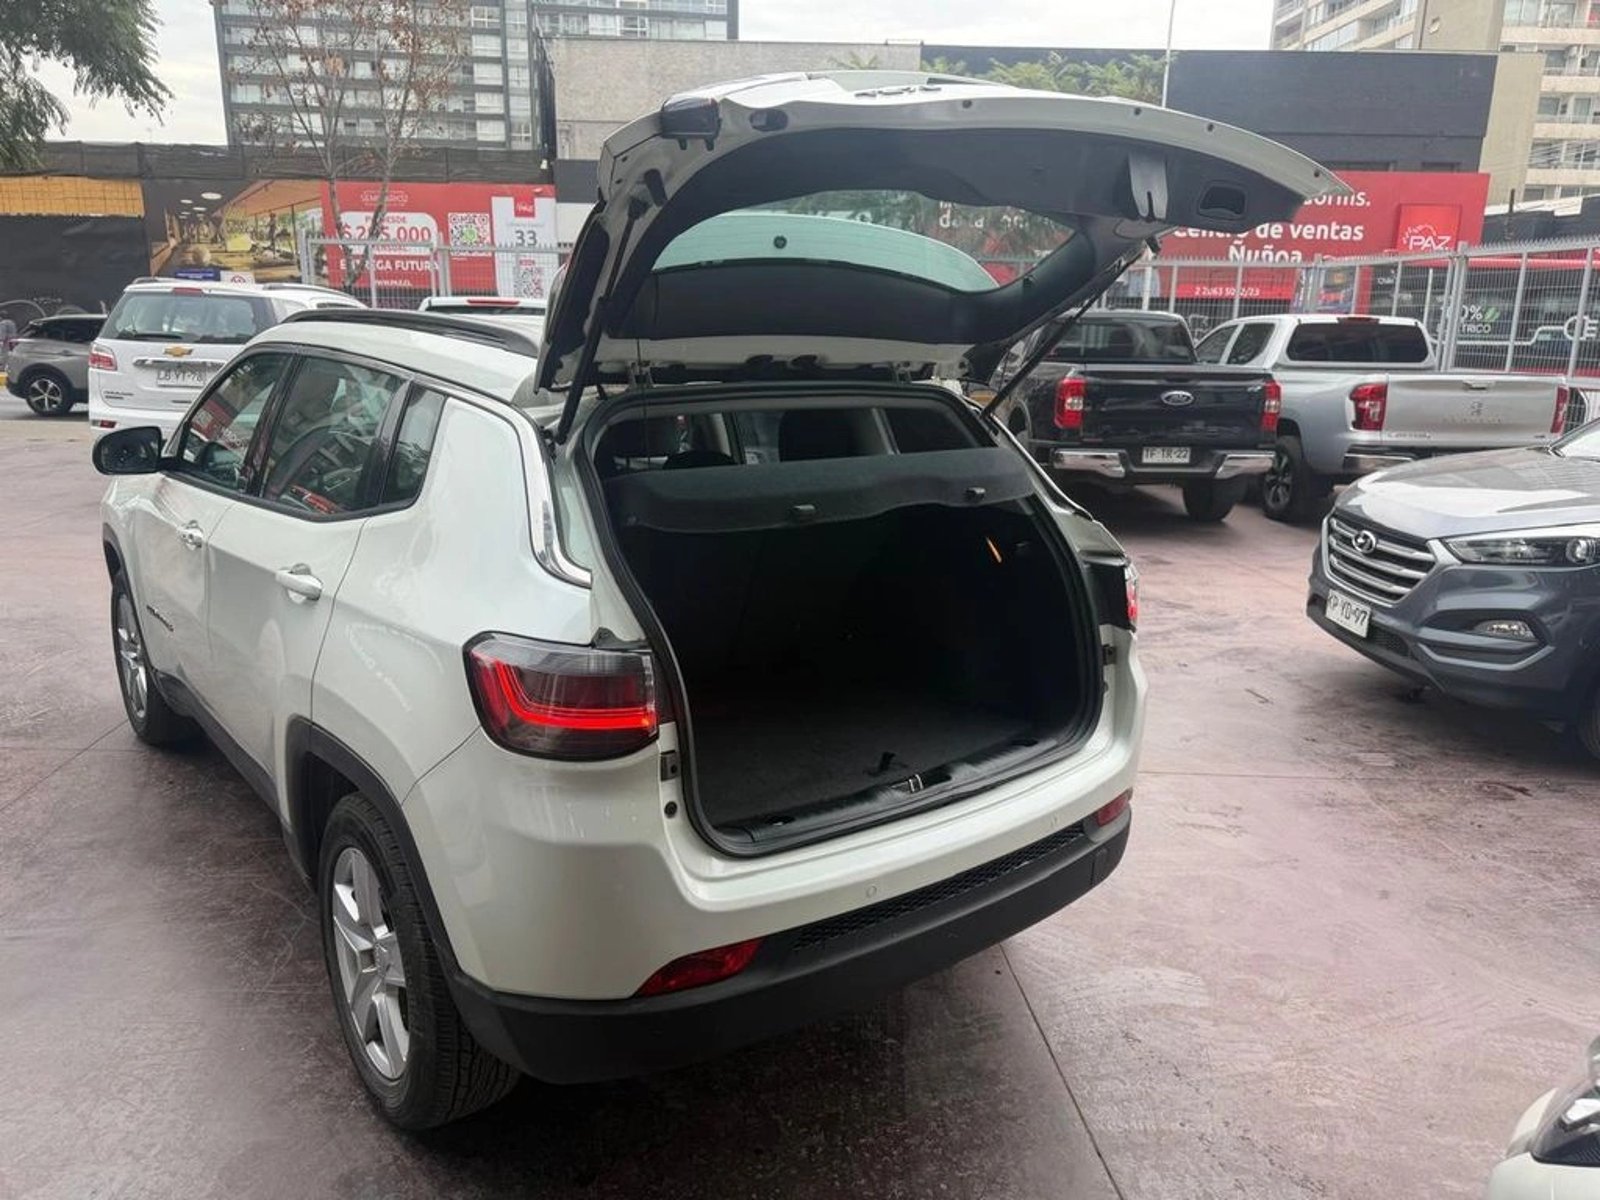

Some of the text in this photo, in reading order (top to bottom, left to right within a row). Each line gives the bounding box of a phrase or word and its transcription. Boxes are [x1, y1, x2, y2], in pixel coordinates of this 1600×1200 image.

[515, 230, 537, 247] 33
[1289, 221, 1364, 241] ventas
[1228, 239, 1303, 263] Ñuñoa
[1408, 235, 1451, 250] PAZ
